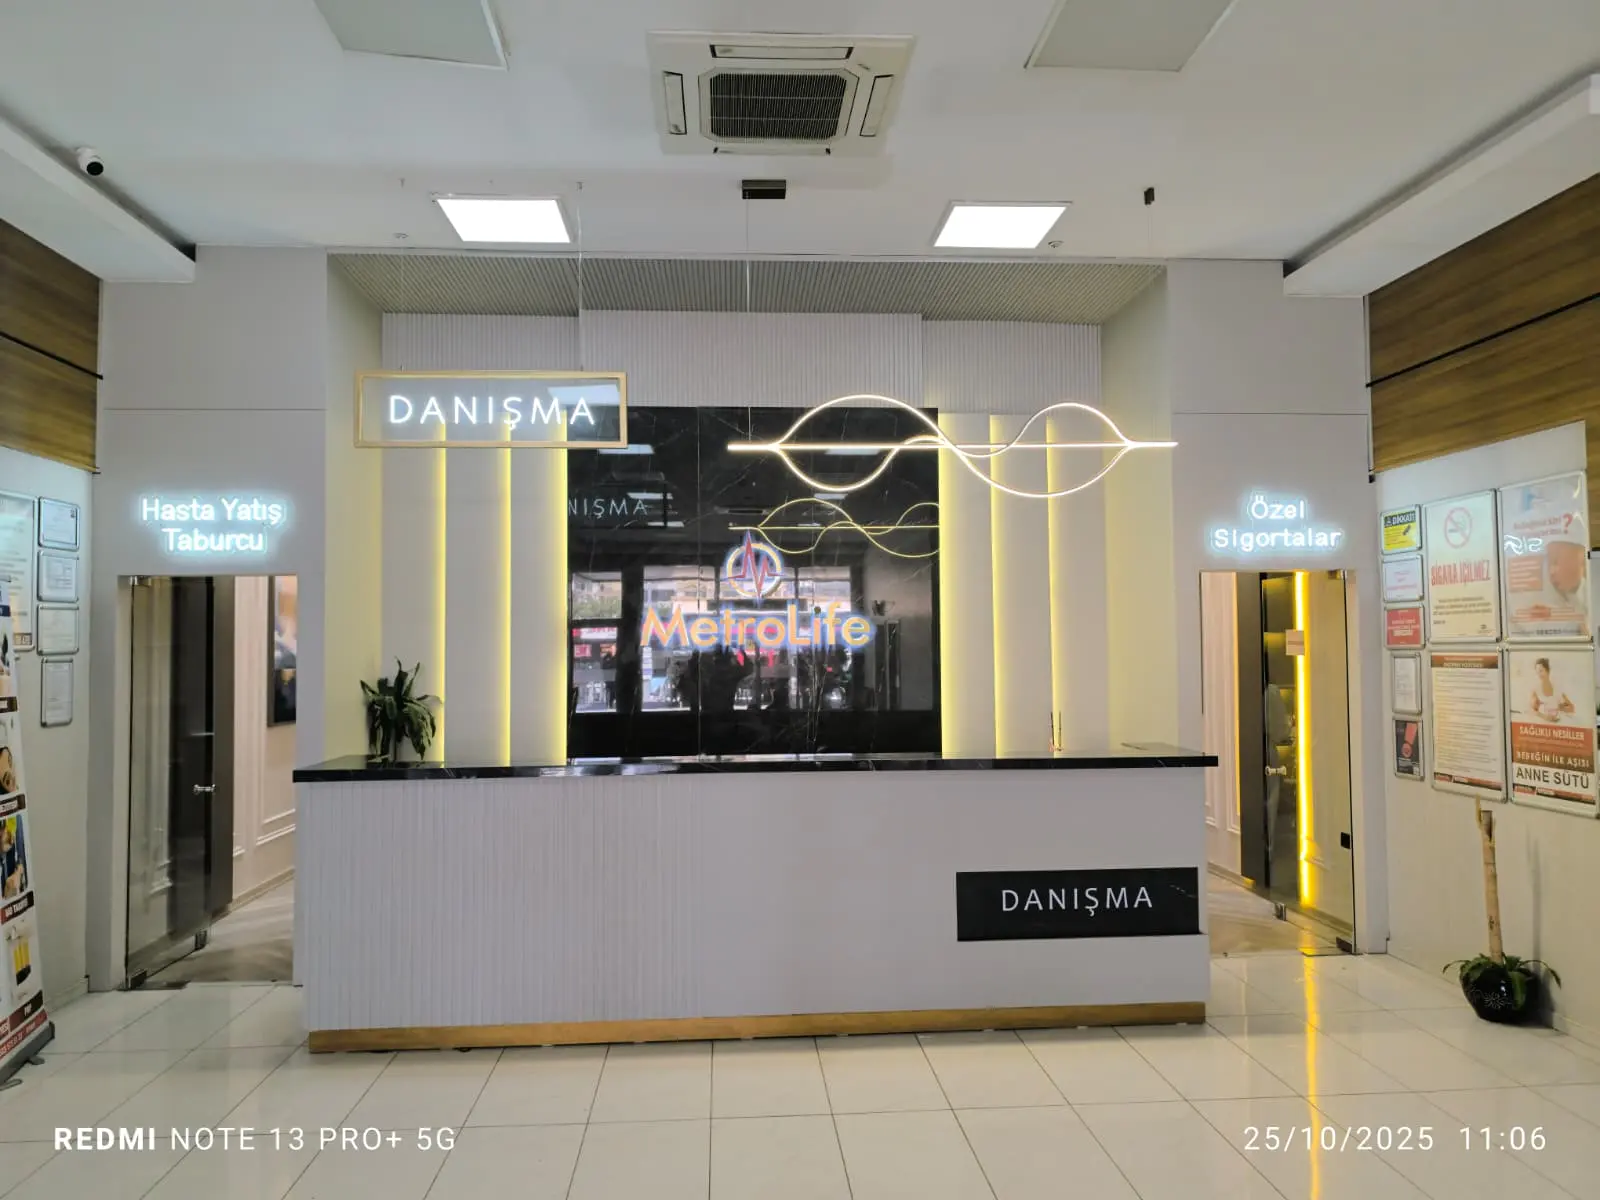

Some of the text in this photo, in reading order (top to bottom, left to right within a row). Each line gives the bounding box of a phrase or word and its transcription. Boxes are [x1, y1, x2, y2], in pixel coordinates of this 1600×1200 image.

[389, 394, 596, 430] DANIŞMA
[142, 498, 283, 525] Hasta Yatış
[568, 497, 648, 519] NIŞMA
[1251, 495, 1304, 520] Özel
[161, 527, 264, 551] Taburcu
[1214, 528, 1342, 552] Sigortalar
[640, 601, 871, 648] MetroLife
[1516, 767, 1589, 789] ANNE SÜTÜ
[1001, 886, 1153, 916] DANIŞMA
